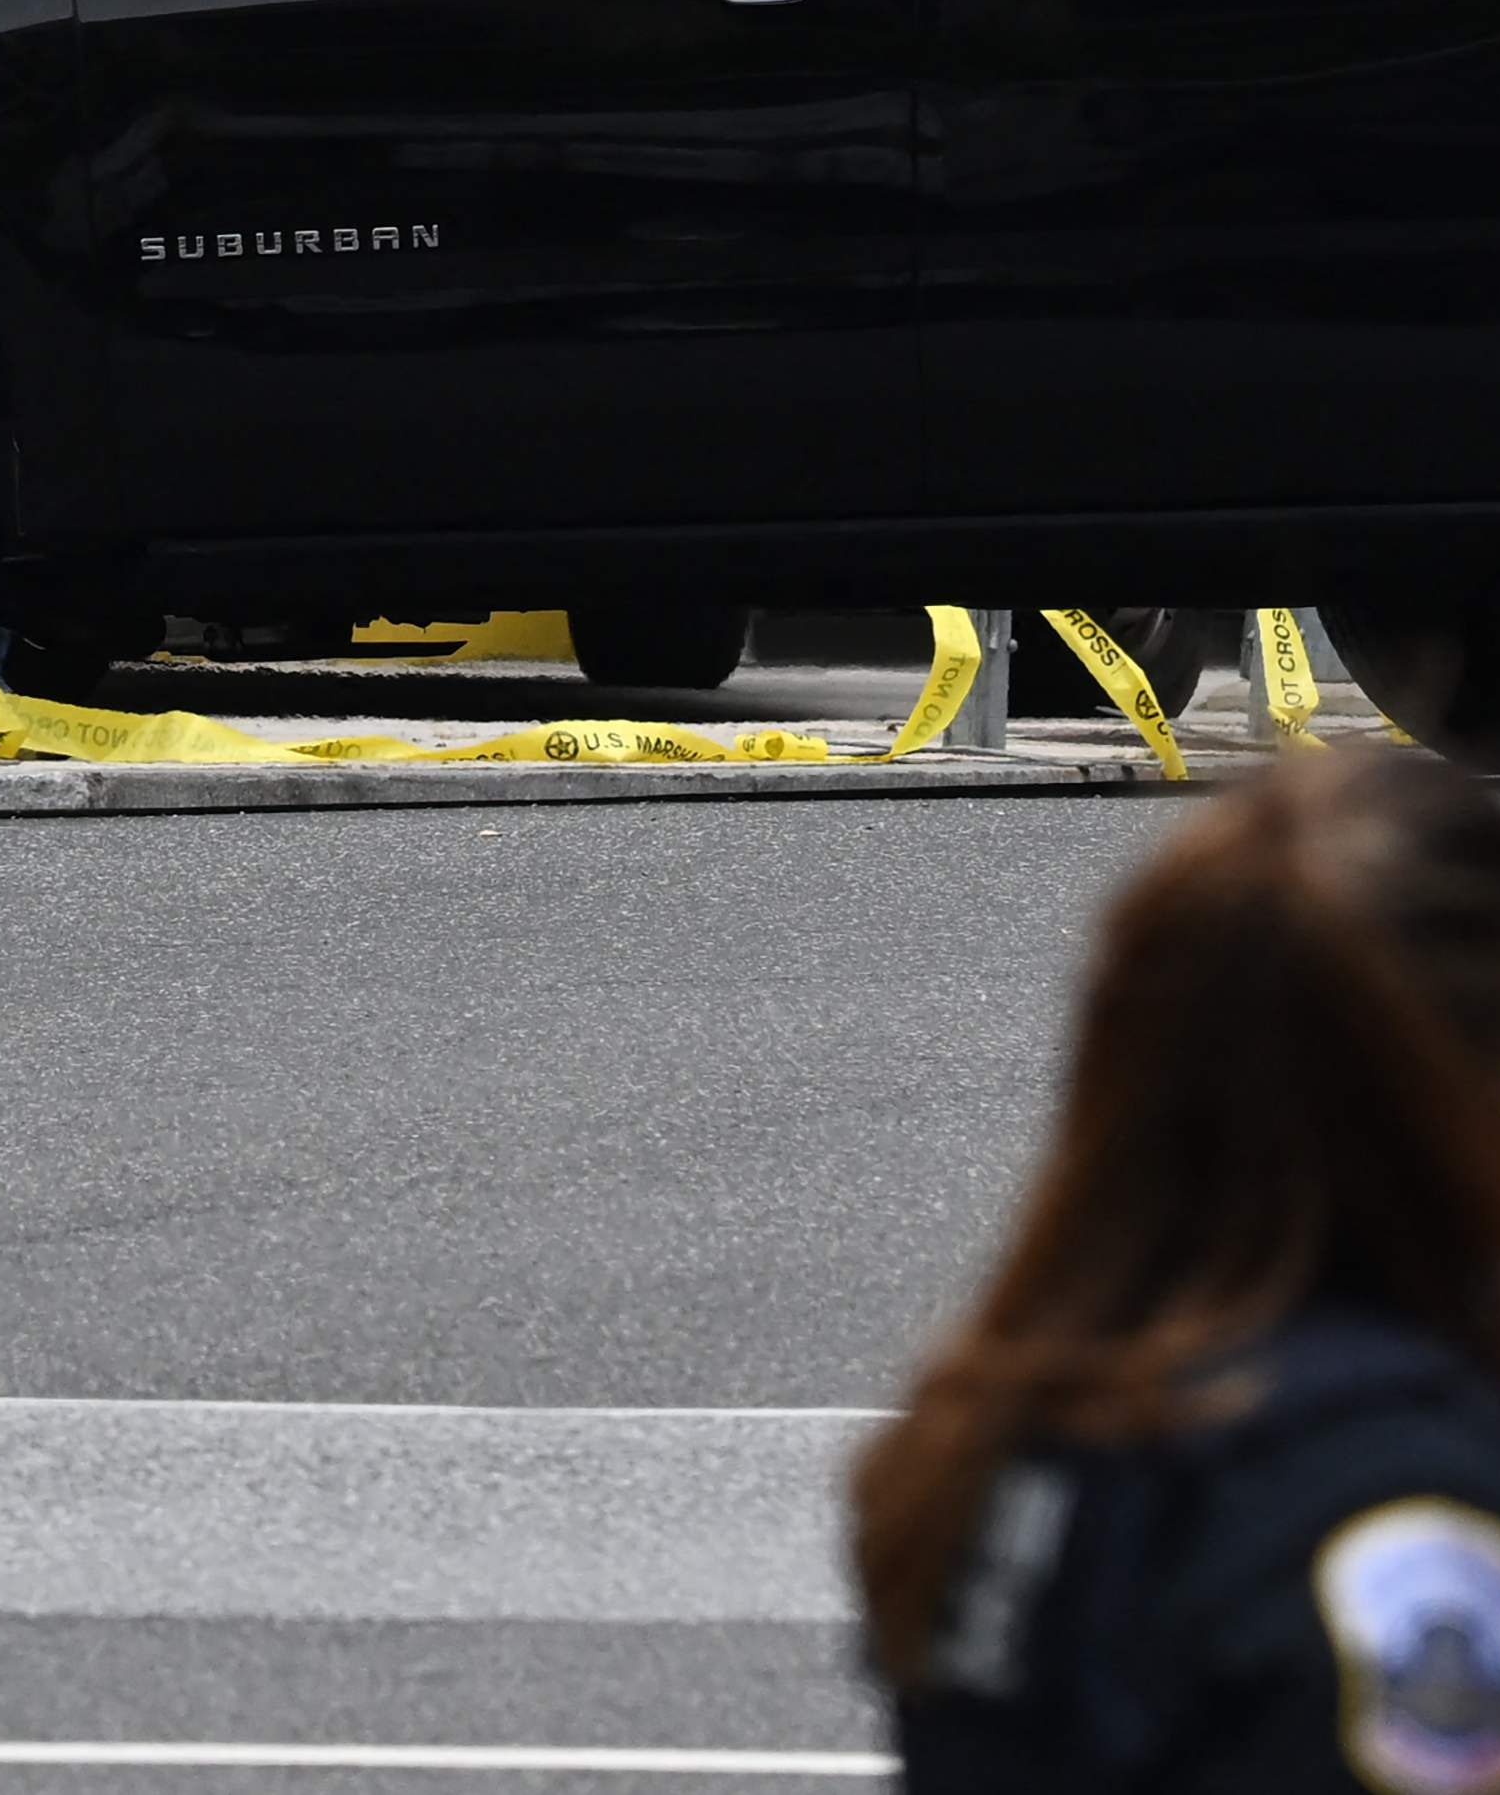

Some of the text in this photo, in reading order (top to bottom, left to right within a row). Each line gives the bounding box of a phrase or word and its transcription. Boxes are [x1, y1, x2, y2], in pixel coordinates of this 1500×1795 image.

[140, 223, 439, 261] SUBURBAN
[1064, 609, 1120, 667] ROSS
[1272, 609, 1296, 673] CROS
[1281, 678, 1304, 708] OT
[583, 732, 630, 751] U.S.
